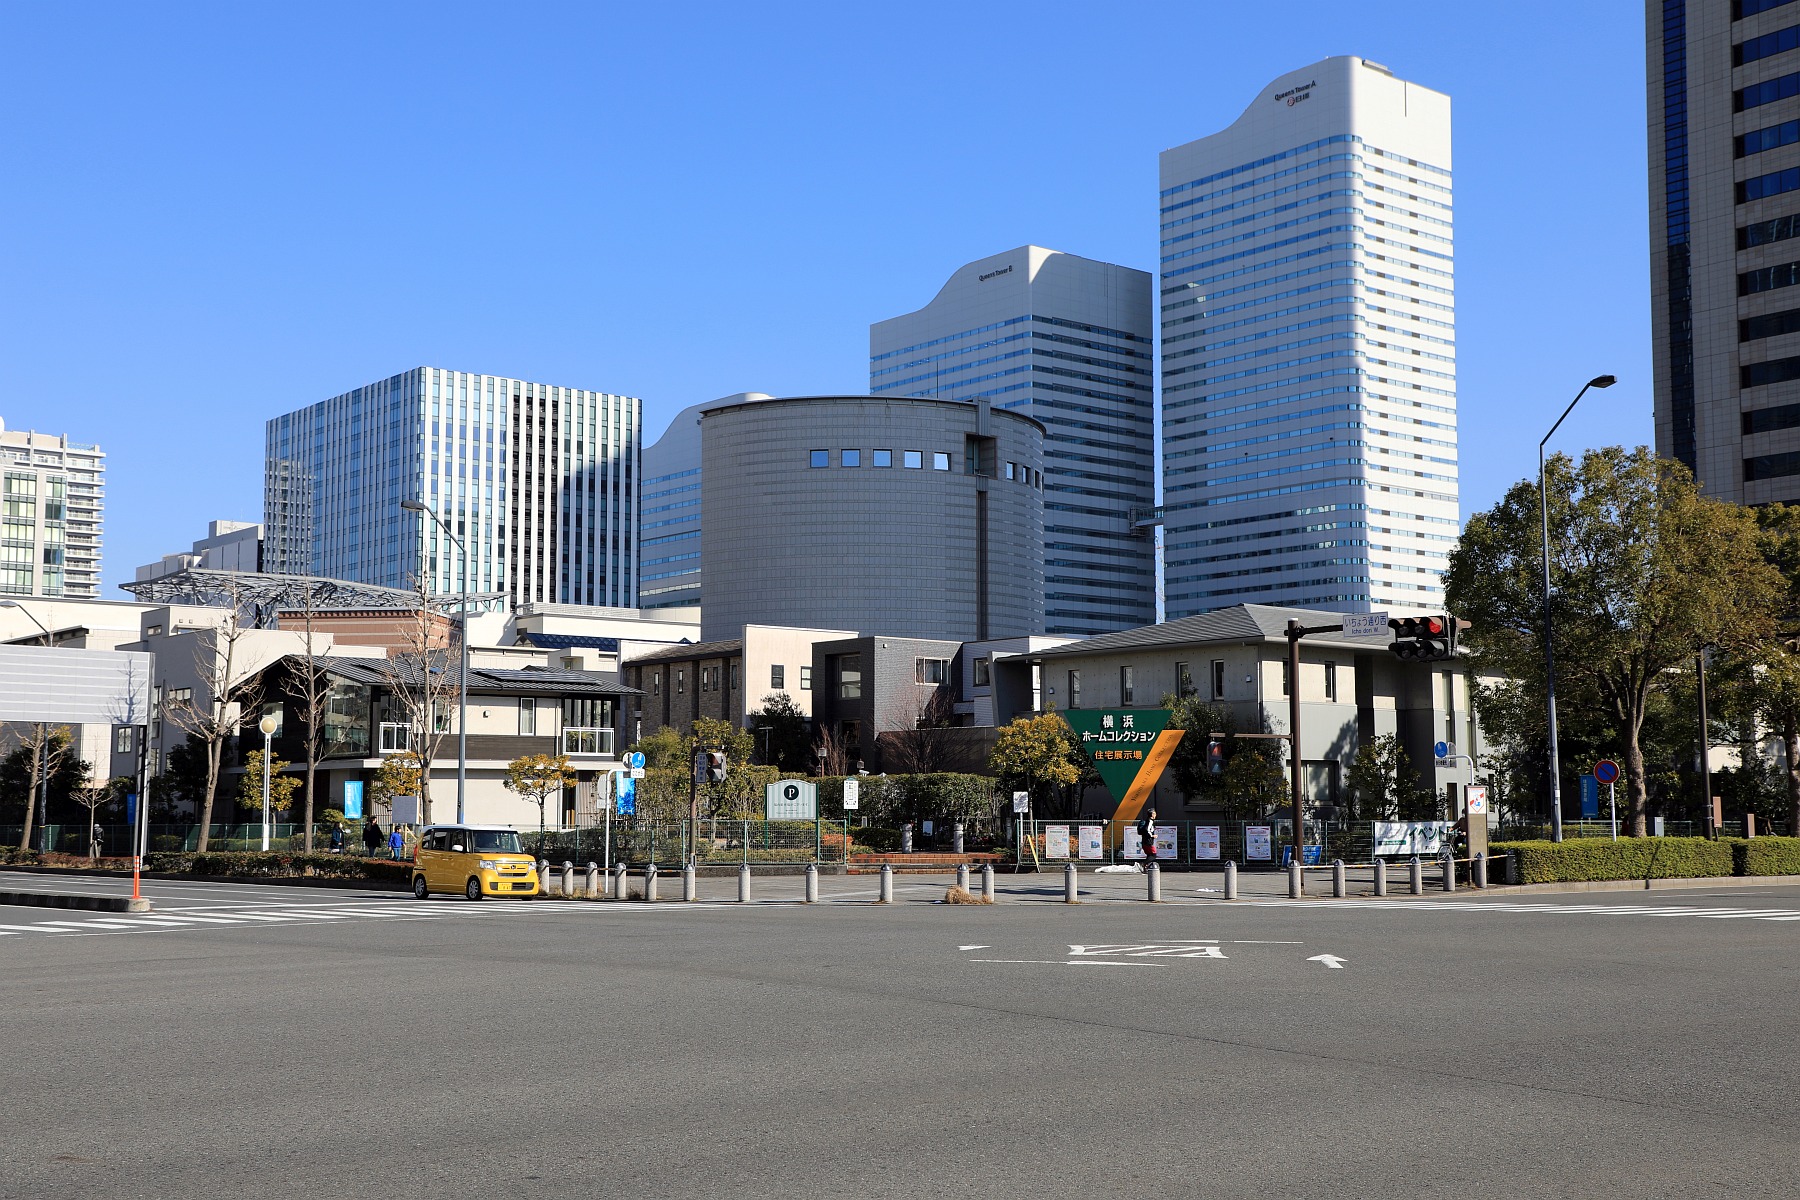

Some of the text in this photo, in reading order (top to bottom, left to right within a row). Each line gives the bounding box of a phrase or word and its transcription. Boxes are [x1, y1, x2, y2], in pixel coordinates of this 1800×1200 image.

[1311, 80, 1316, 88] A
[1345, 615, 1386, 627] いちょう通り西
[1082, 730, 1156, 742] ホームコレクション
[1094, 750, 1143, 760] 住宅展示場
[788, 788, 796, 798] P
